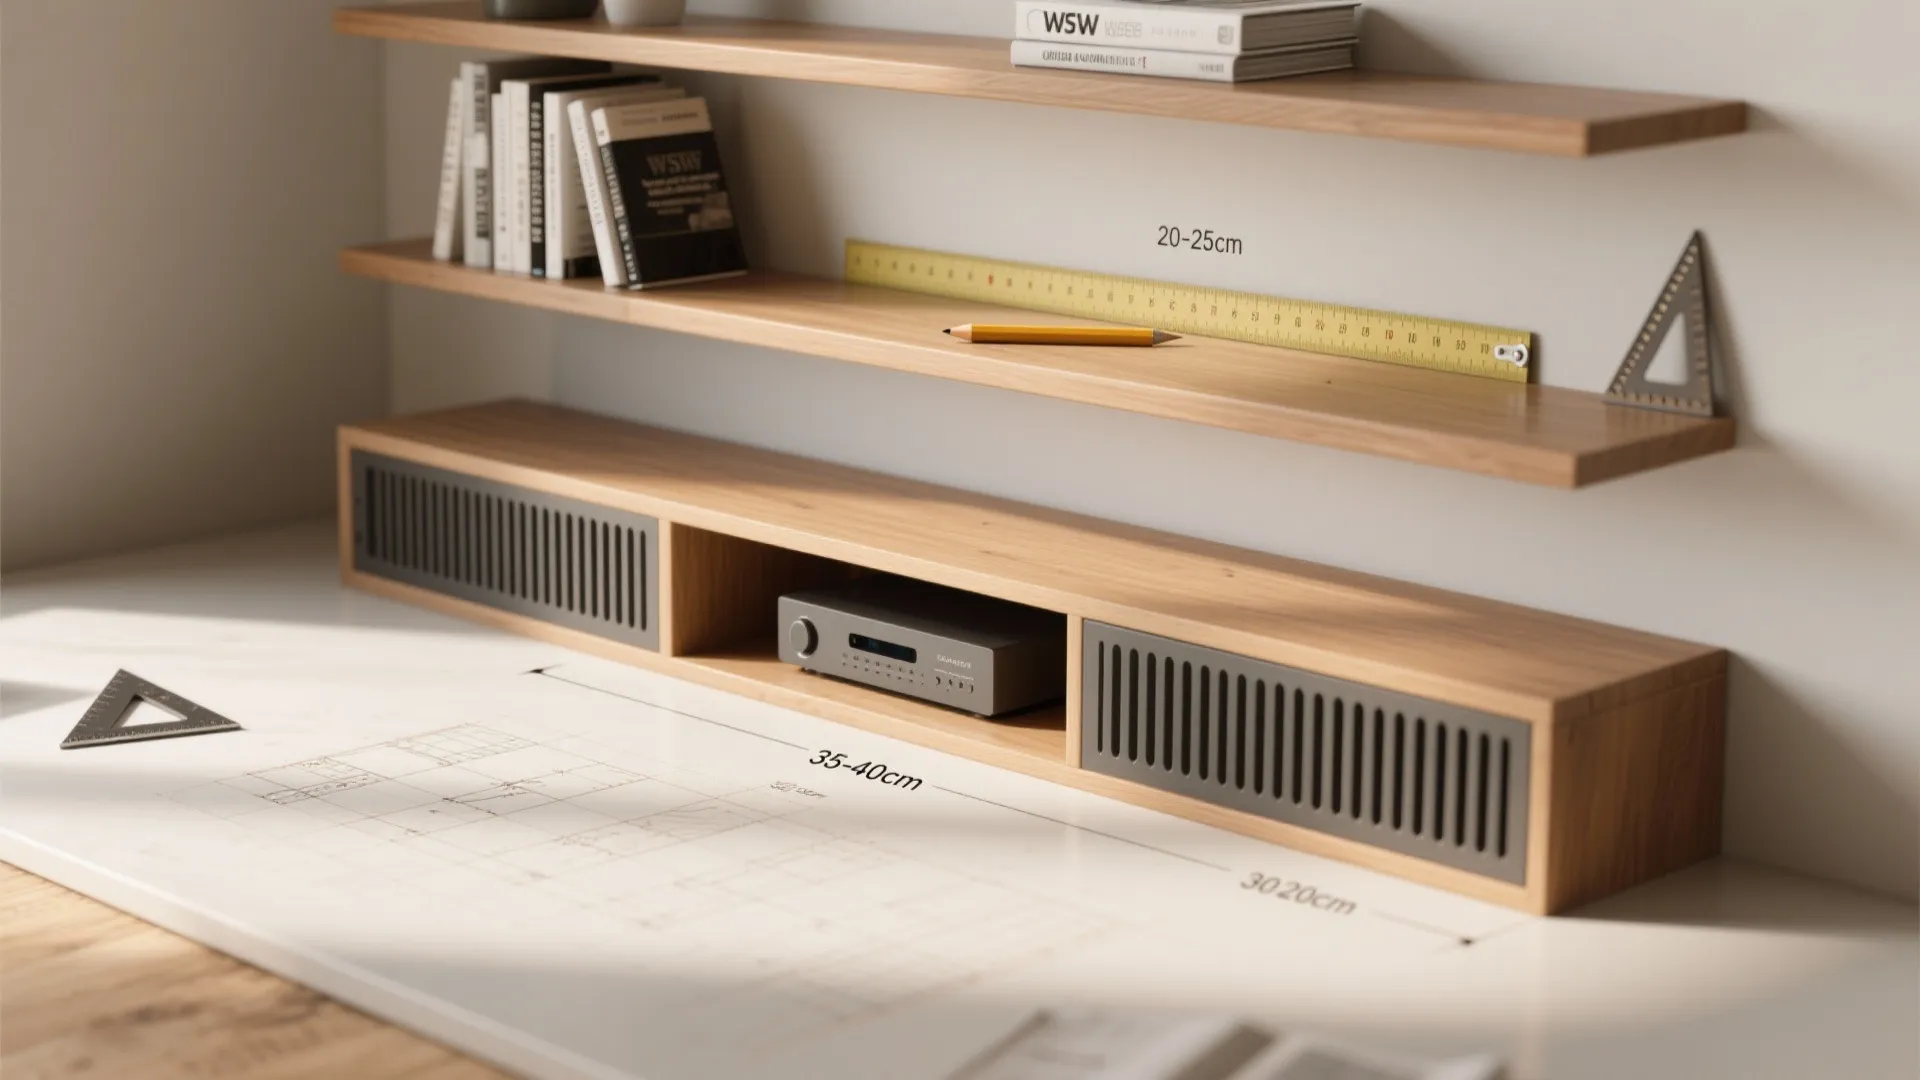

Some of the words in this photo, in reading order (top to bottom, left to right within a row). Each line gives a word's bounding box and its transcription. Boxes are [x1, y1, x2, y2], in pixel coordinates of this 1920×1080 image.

[1043, 10, 1100, 37] WSW
[1157, 225, 1242, 255] 20-25cm
[809, 749, 923, 791] 35-40cm
[1240, 871, 1357, 915] 3020cm
